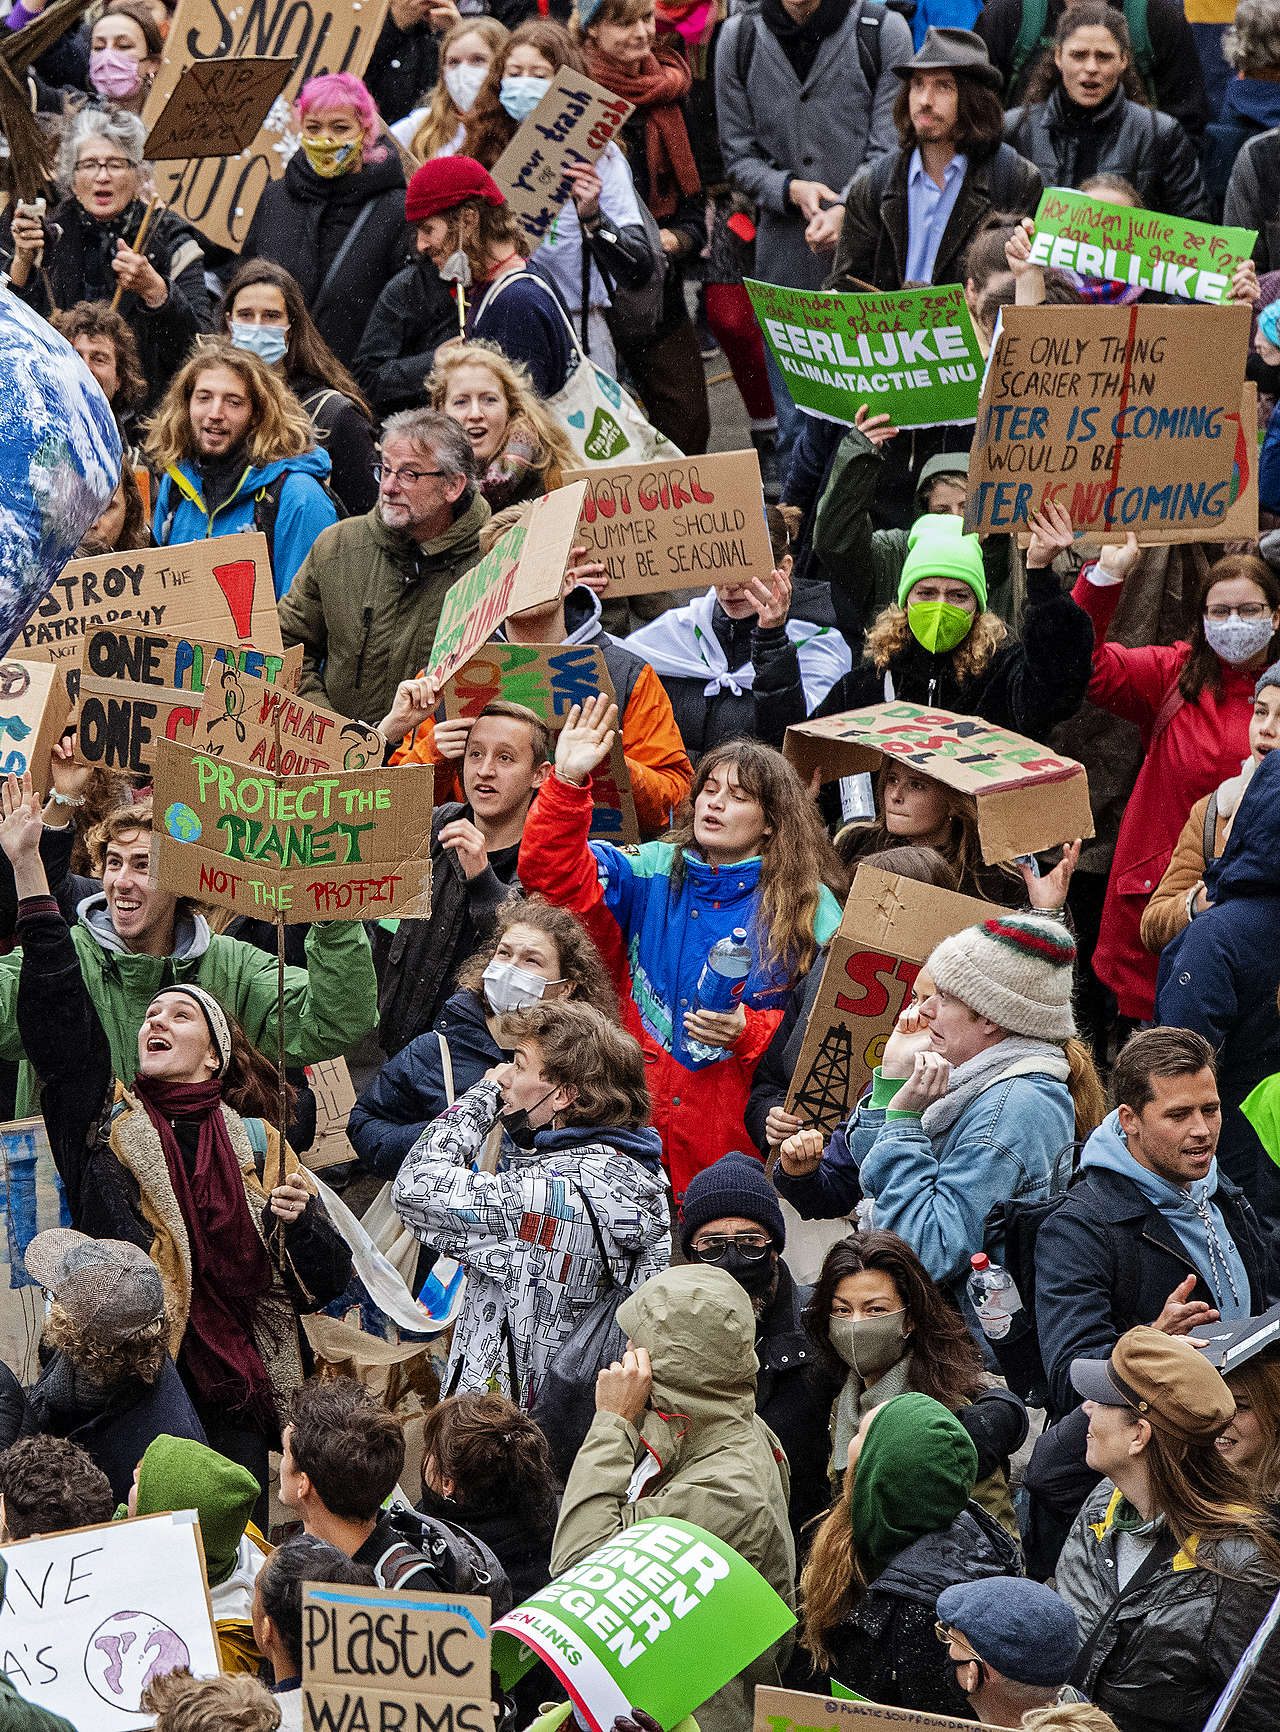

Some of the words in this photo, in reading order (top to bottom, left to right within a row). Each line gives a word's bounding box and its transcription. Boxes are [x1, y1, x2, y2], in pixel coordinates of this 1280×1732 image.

[535, 87, 593, 143] trash
[586, 99, 630, 150] crash
[1070, 202, 1122, 232] vinden
[1128, 216, 1174, 243] jullie
[1025, 231, 1229, 305] EERLIJKE
[764, 317, 970, 368] EERLIJKE
[1030, 336, 1092, 366] ONLY
[1099, 336, 1169, 366] THING
[778, 354, 933, 393] KLIMAATACTIE
[937, 363, 977, 385] NU
[995, 370, 1082, 399] SCARIER
[1087, 371, 1157, 398] THAN
[1066, 405, 1102, 443] IS
[1111, 405, 1226, 442] COMING
[987, 443, 1079, 474] WOULD
[1091, 444, 1124, 472] BE
[638, 465, 715, 512] GIRL
[1103, 481, 1231, 525] COMING
[579, 517, 658, 552] SUMMER
[671, 507, 746, 538] SHOULD
[154, 566, 194, 590] THE
[584, 554, 626, 580] NLY
[635, 550, 660, 578] BE
[667, 538, 753, 574] SEASONAL
[48, 644, 78, 662] NOT
[87, 630, 170, 687] ONE
[79, 696, 159, 775] ONE
[258, 688, 336, 746] WHAT
[836, 729, 938, 765] FOOL
[1004, 747, 1066, 774] BE
[190, 755, 341, 822] PROTECT
[337, 788, 392, 815] THE
[216, 813, 377, 870] PLANET
[199, 862, 243, 900] NOT
[247, 880, 295, 911] THE
[305, 874, 404, 912] PROFIT
[3, 1546, 104, 1616] VE
[502, 1612, 583, 1668] ENLINKS
[534, 1584, 649, 1670] EGEN
